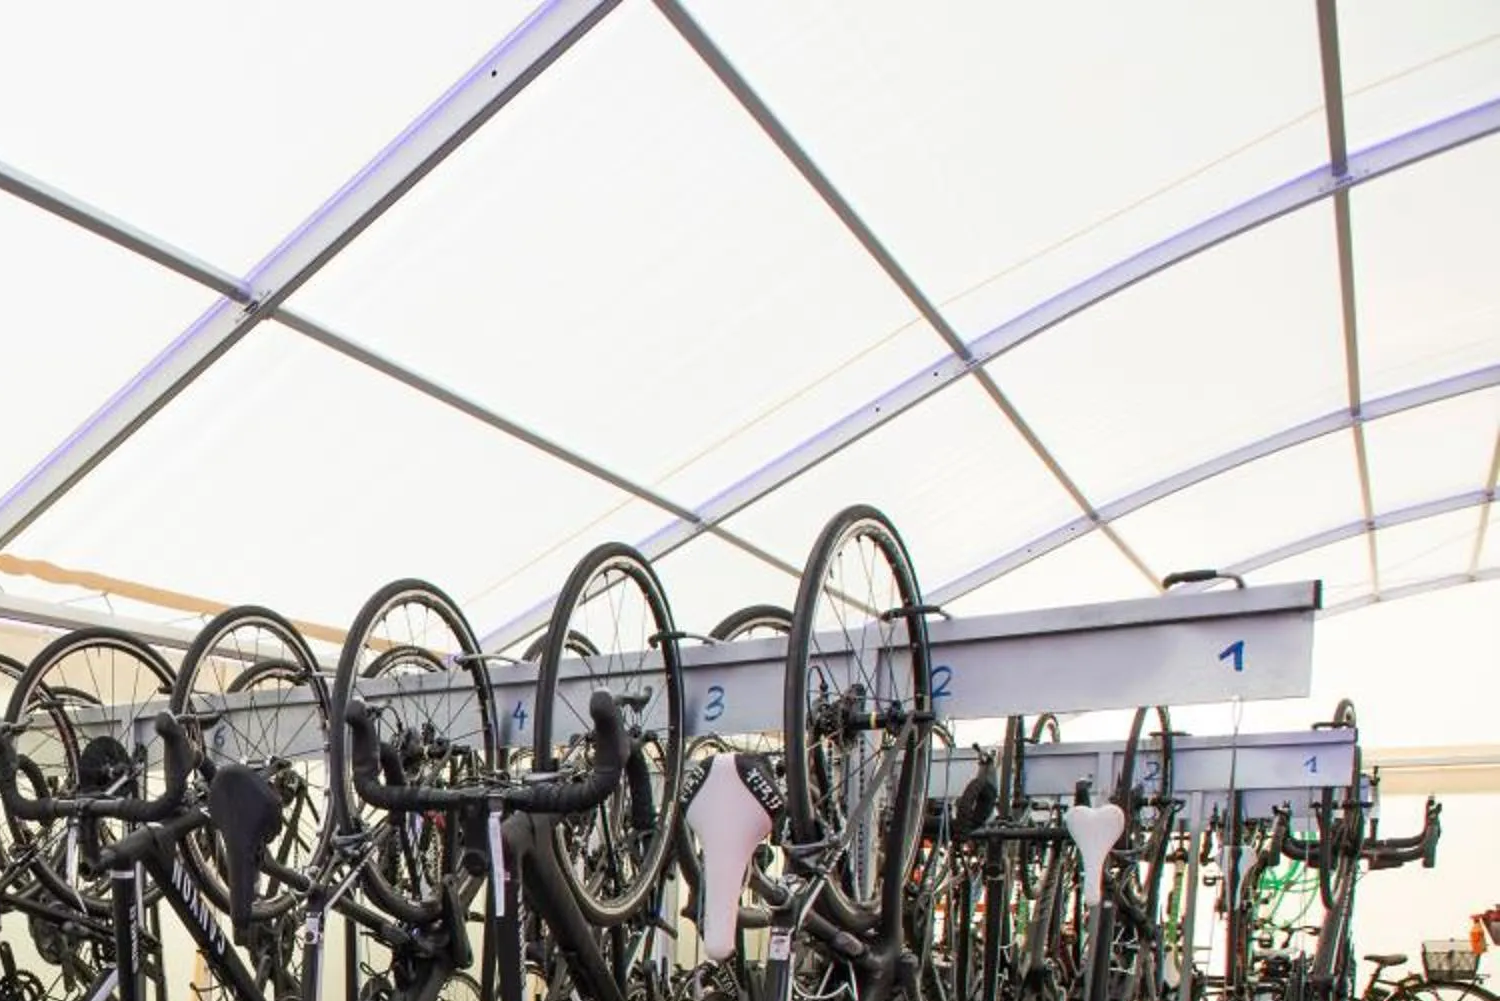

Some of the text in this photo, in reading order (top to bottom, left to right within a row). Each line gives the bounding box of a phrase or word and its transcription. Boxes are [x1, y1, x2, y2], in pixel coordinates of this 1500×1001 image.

[1218, 640, 1245, 672] 1
[930, 665, 952, 698] 2
[512, 701, 529, 730] 4
[703, 686, 726, 721] 3
[212, 726, 226, 745] 6
[1143, 761, 1161, 781] 2
[1304, 755, 1318, 772] 1
